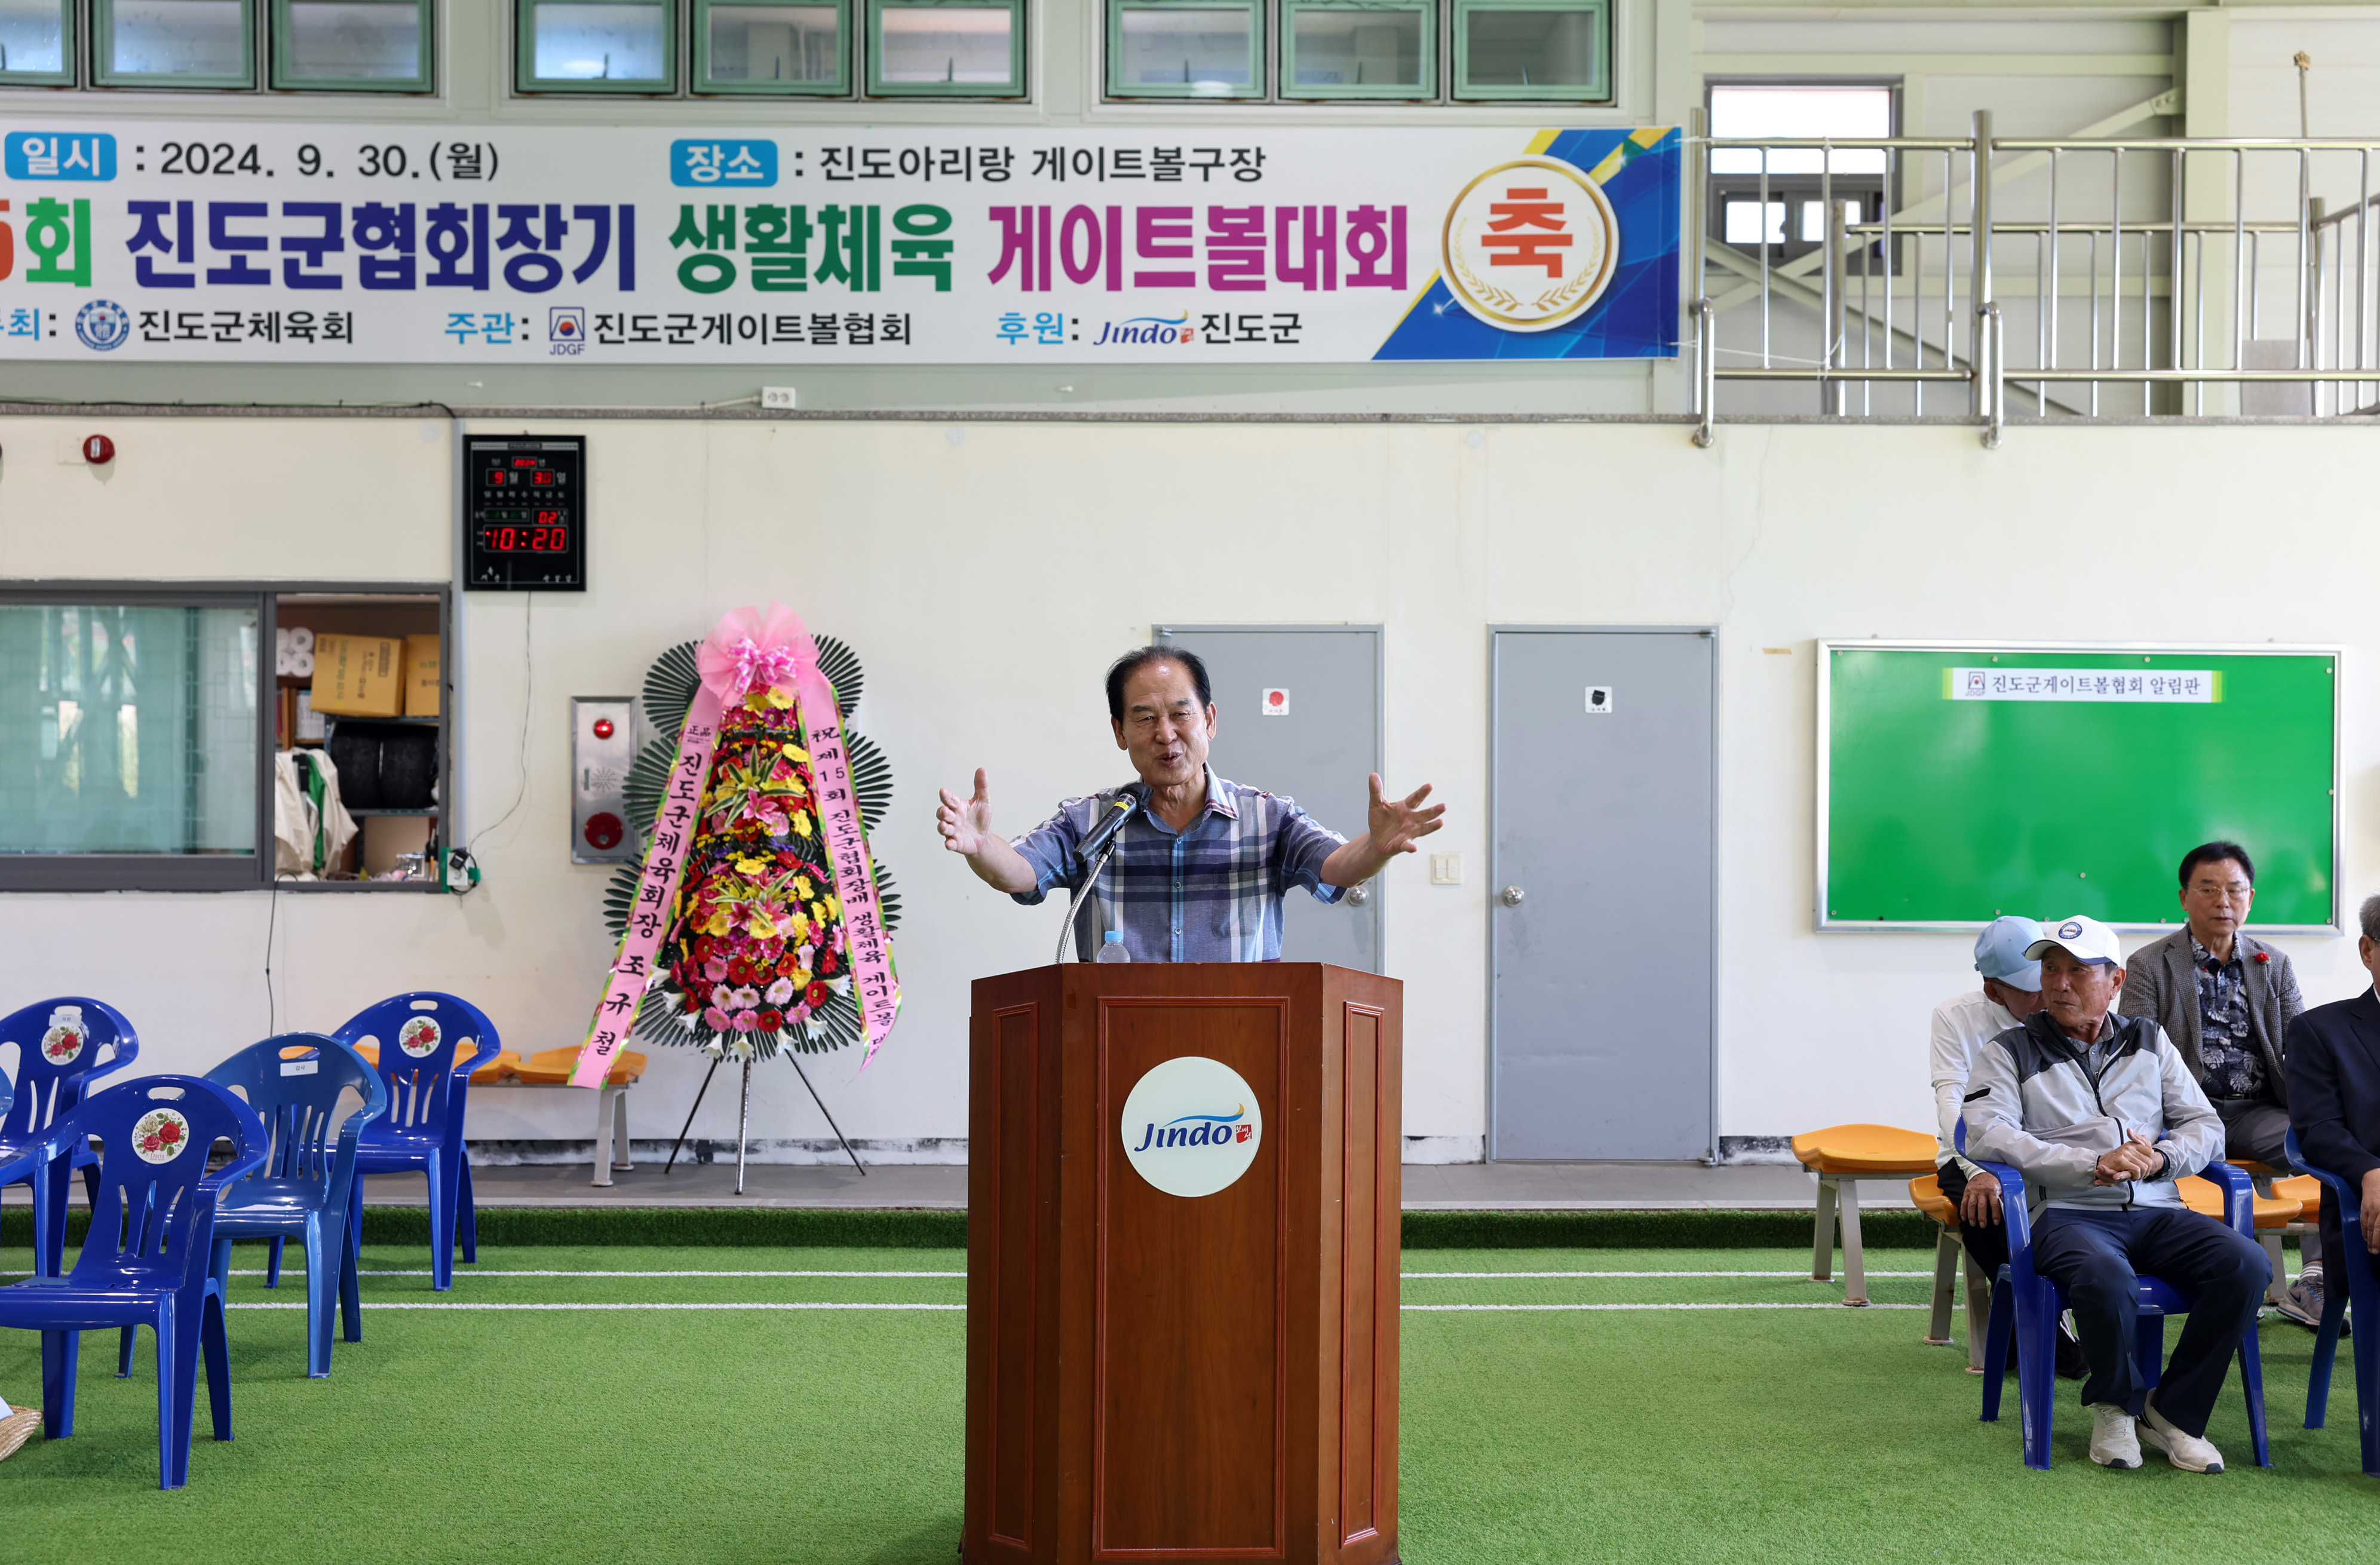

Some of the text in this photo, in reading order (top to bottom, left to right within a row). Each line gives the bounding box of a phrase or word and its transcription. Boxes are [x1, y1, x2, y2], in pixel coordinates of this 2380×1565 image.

[22, 137, 100, 176] 일시
[298, 144, 335, 177] 9.
[358, 142, 498, 181] 30.(월)
[686, 145, 764, 182] 장소
[820, 146, 1015, 182] 진도아리랑
[1032, 146, 1266, 182] 게이트볼구장
[125, 200, 635, 294] 진도군협회장기
[668, 204, 954, 294] 생활체육
[987, 204, 1407, 291] 게이트볼대회
[1482, 188, 1573, 278] 축
[0, 309, 57, 341] 최:
[139, 310, 352, 343] 진도군체육회
[445, 313, 910, 345] 주관: 진도군게이트볼협회
[996, 312, 1078, 345] 후원:
[1093, 321, 1177, 345] Jindo
[1201, 313, 1302, 344] 진도군
[550, 343, 585, 355] JDGF
[495, 471, 504, 484] 9
[533, 472, 552, 484] 30
[538, 511, 558, 524] 02
[491, 528, 566, 550] 10:20
[1992, 675, 2201, 695] 진도군게이트볼협회 알림판
[634, 752, 703, 938] 진도군체육회장
[827, 809, 871, 904] 진도군협회장배
[850, 912, 886, 964] 생활체육
[862, 972, 895, 1026] 게이트볼
[1134, 1122, 1232, 1152] Jindo
